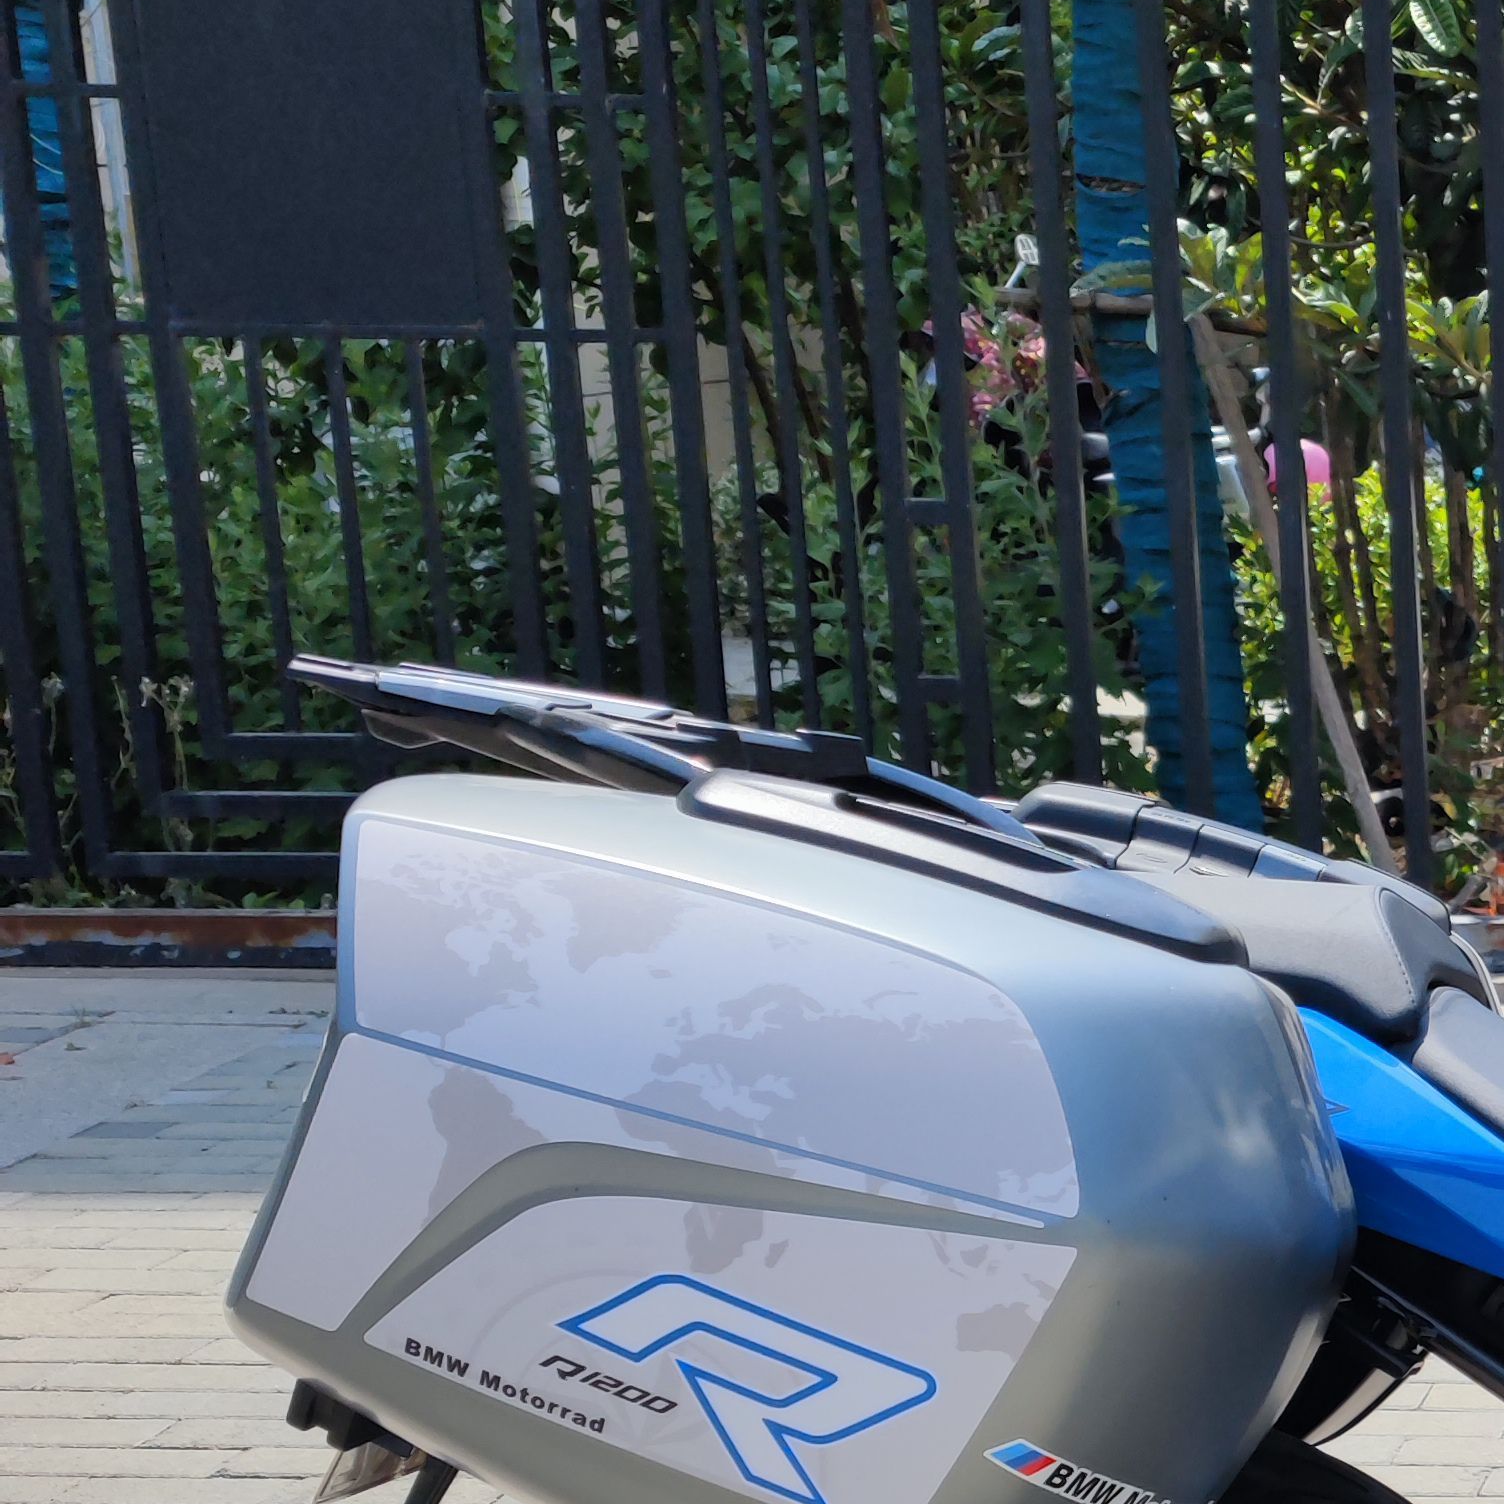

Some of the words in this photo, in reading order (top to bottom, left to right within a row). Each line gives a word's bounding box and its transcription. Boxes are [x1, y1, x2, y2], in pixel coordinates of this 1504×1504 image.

[404, 1337, 470, 1379] BMW
[478, 1369, 606, 1435] Motorrad
[538, 1354, 678, 1415] R1200
